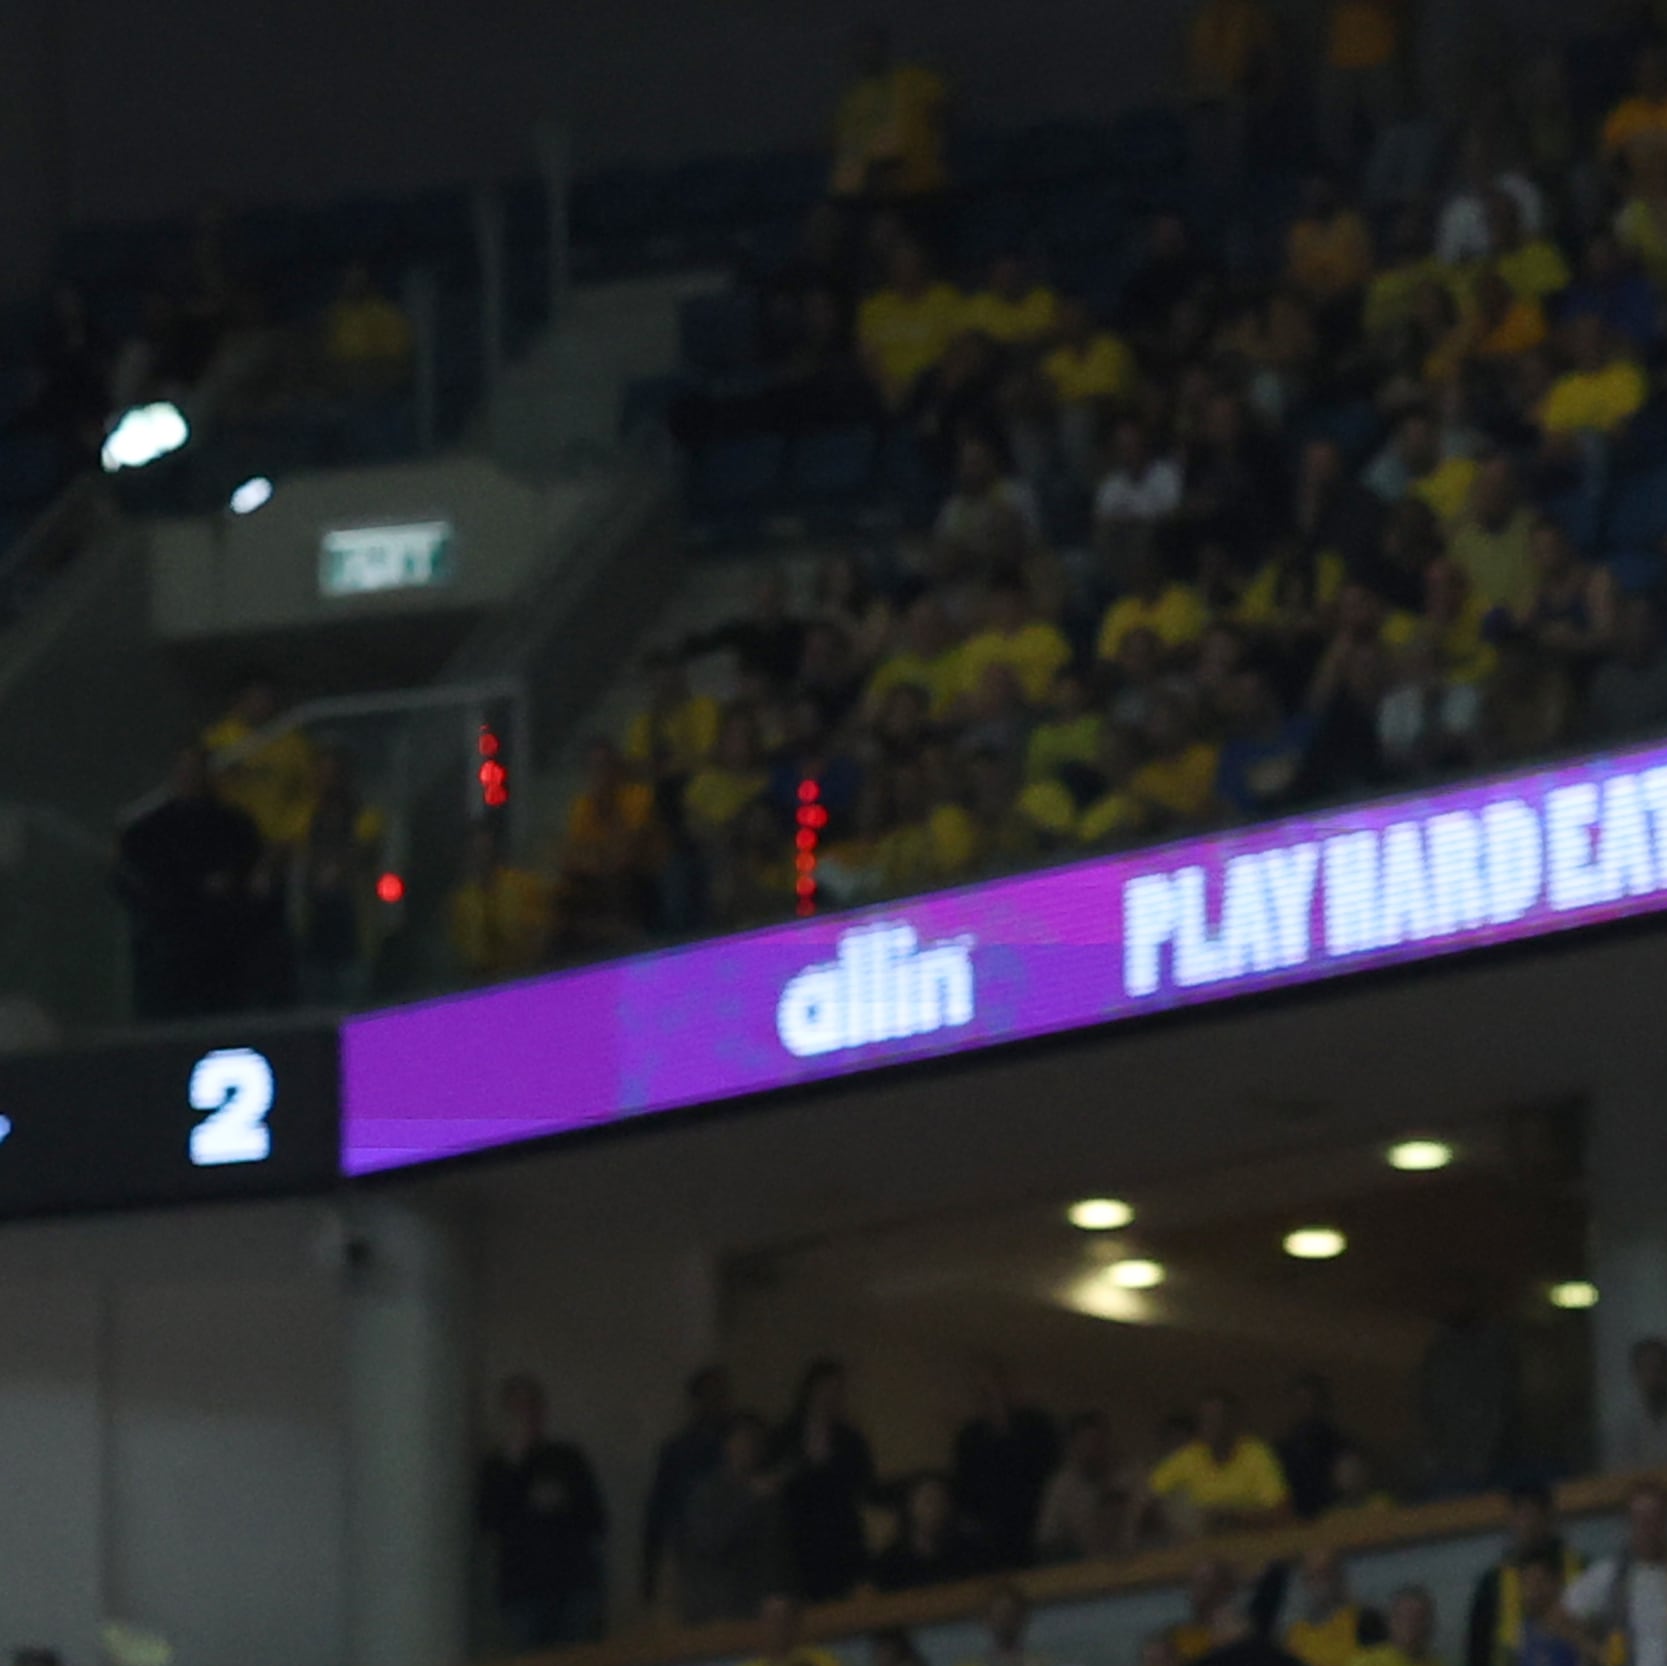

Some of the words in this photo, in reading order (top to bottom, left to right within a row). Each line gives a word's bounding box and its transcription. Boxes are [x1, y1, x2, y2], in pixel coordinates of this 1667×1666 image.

[1122, 844, 1320, 998] PLAY
[1322, 799, 1543, 957] HARD
[189, 1048, 272, 1164] 2
